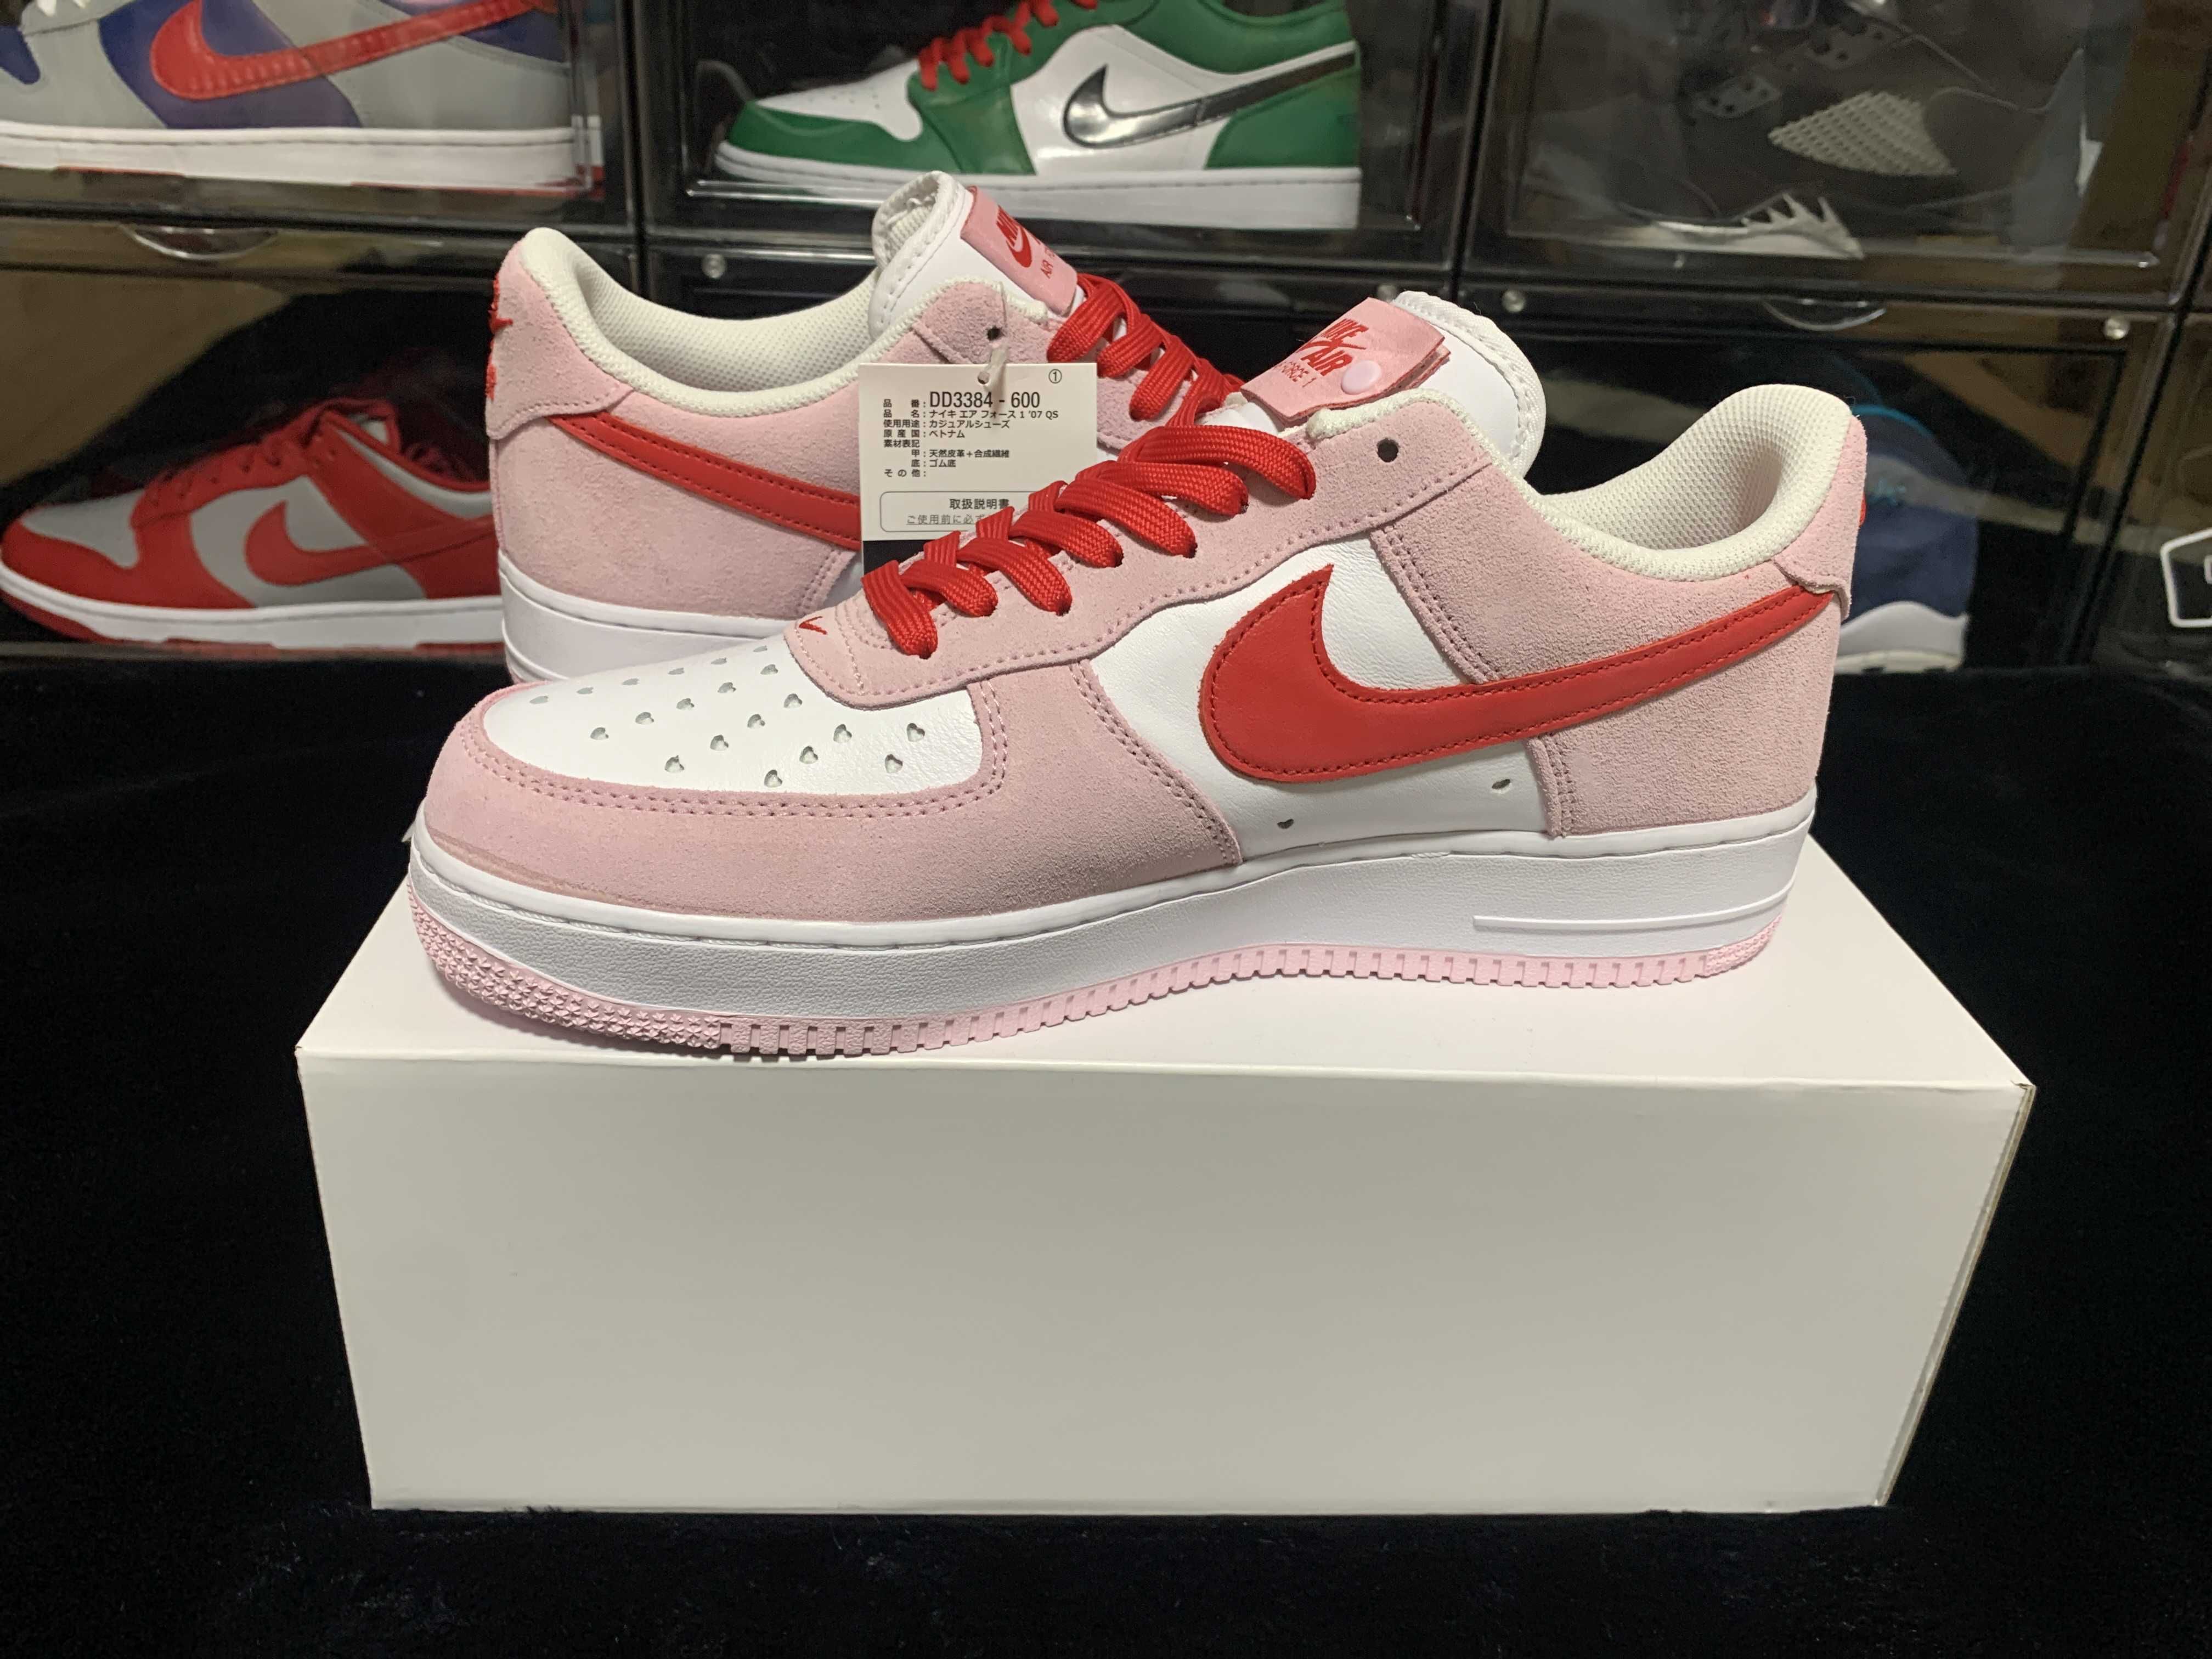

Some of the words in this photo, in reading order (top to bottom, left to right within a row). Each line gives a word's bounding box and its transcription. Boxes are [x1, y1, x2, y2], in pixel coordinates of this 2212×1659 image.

[996, 204, 1019, 247] NIK
[1040, 259, 1053, 279] AIR
[1300, 347, 1352, 376] AIR
[930, 392, 993, 408] DD3384
[1011, 392, 1040, 408] 600
[929, 410, 956, 418] ナイキ
[1046, 411, 1058, 420] QS
[929, 430, 966, 438] ベトナム
[884, 439, 920, 448] 素材表記
[929, 459, 956, 467] ゴム底
